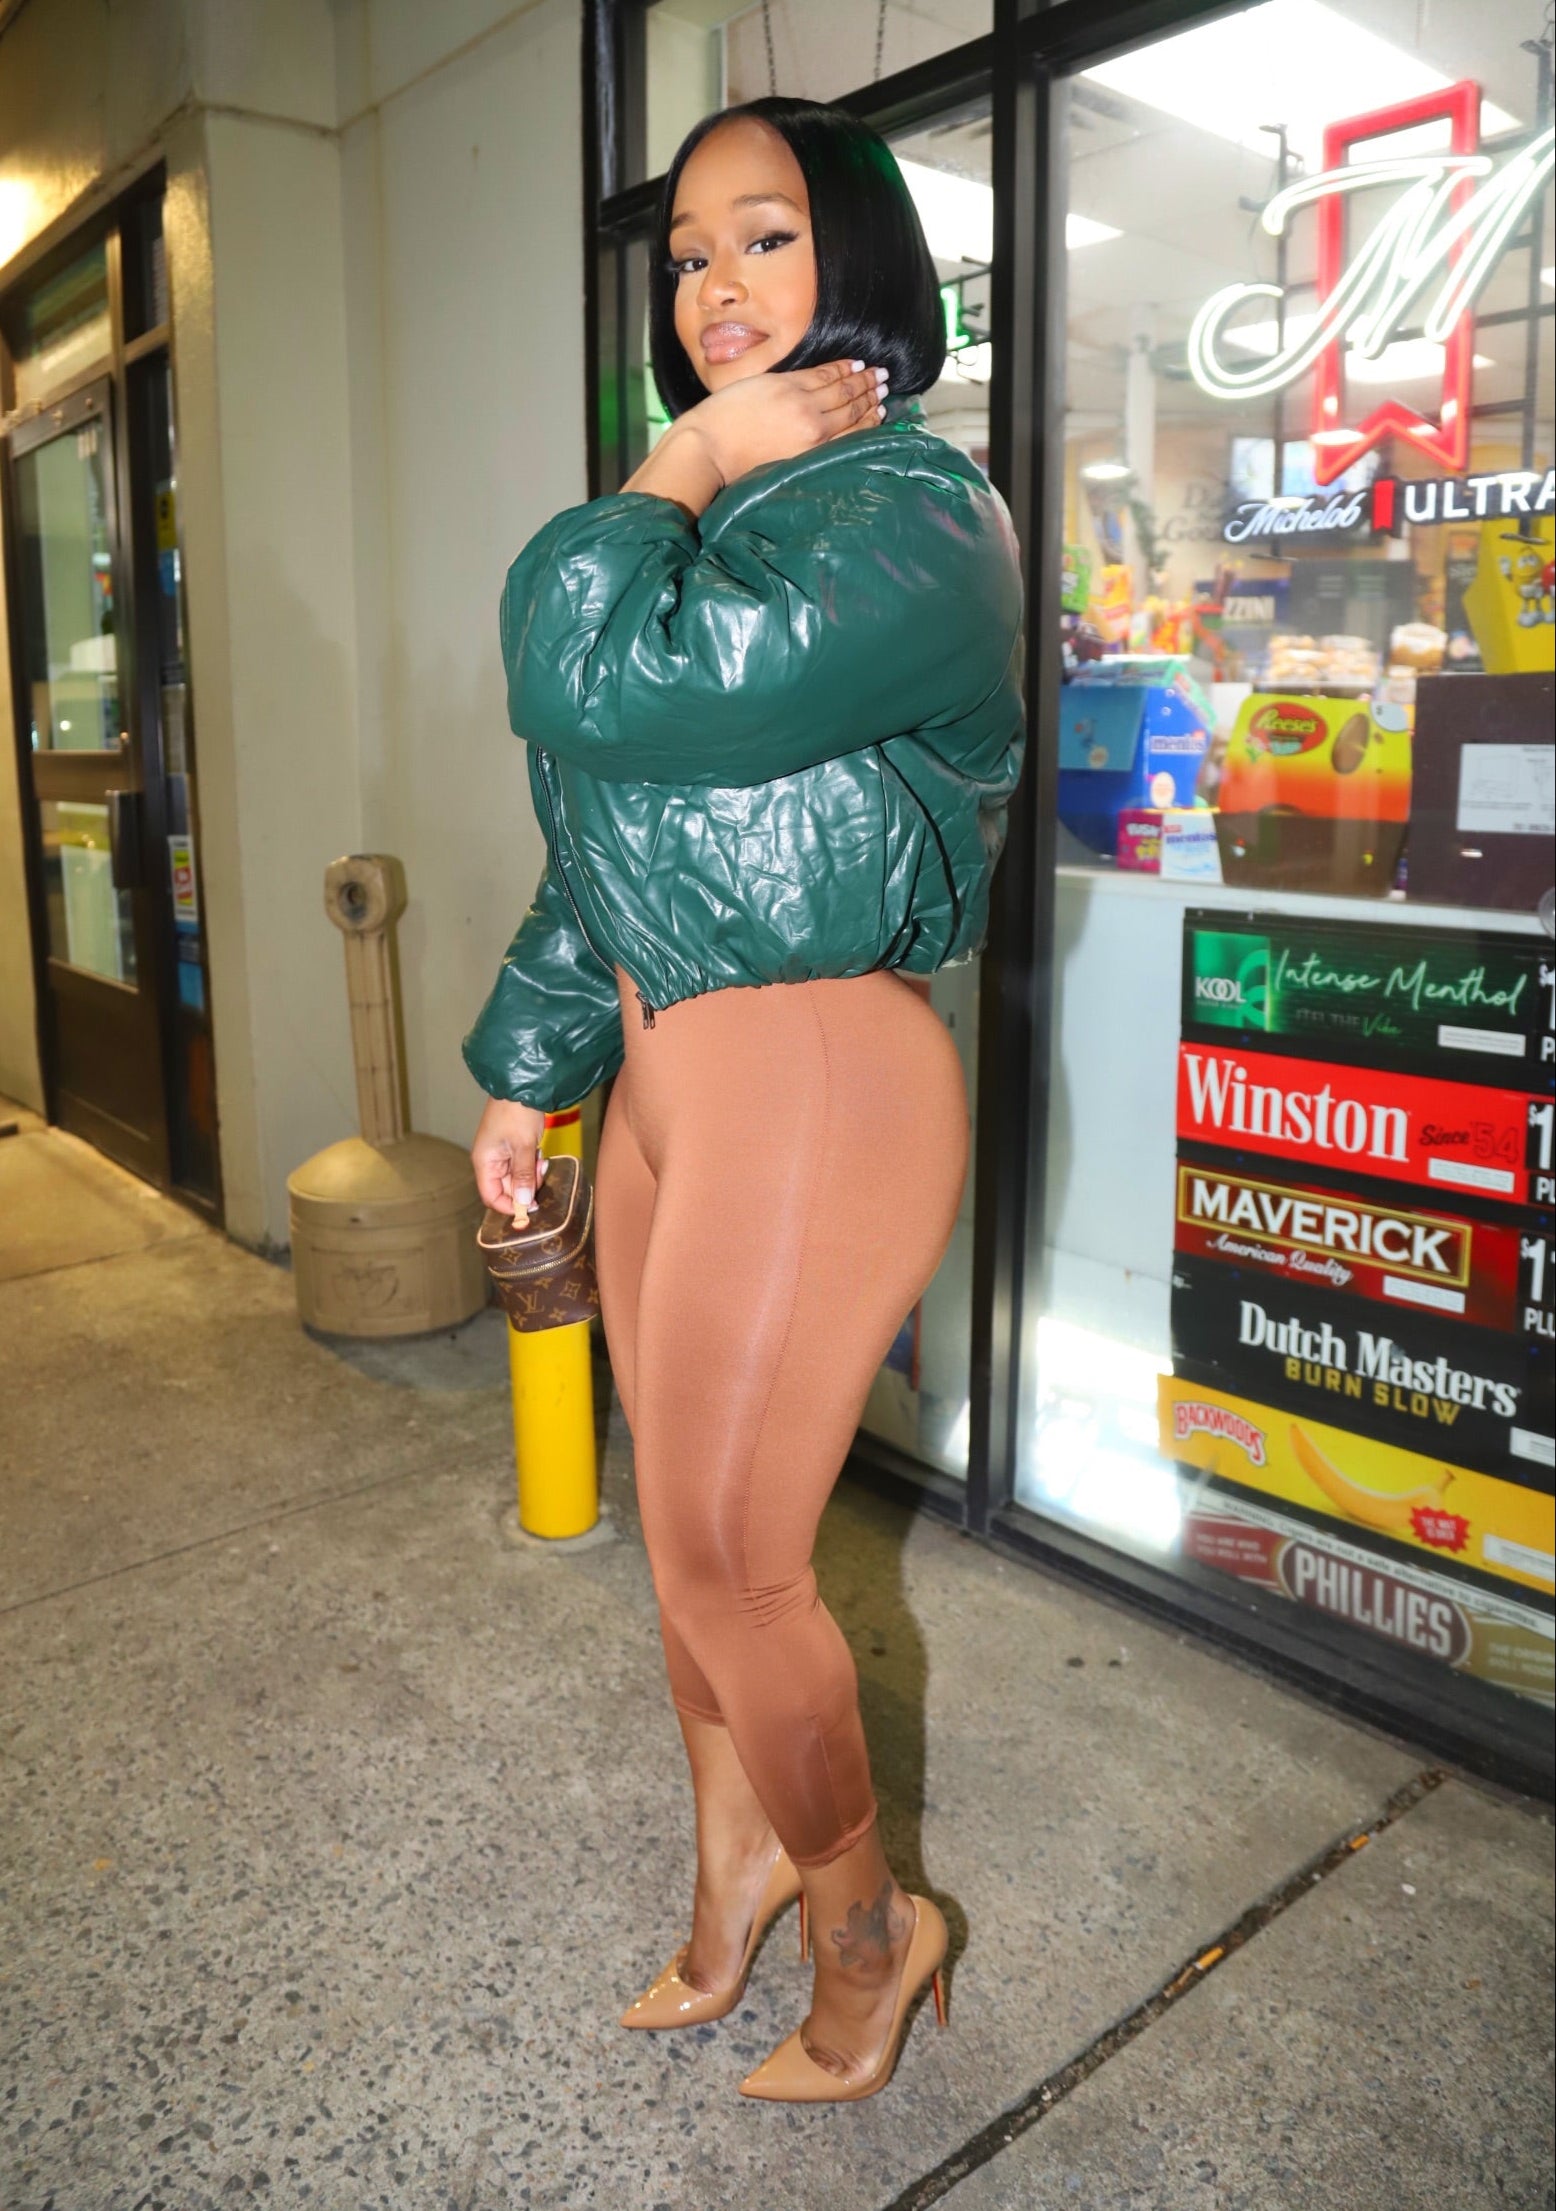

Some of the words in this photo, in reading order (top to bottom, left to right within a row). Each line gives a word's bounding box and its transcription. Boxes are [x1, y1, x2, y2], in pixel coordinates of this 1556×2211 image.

[1224, 492, 1368, 542] Michelob
[1195, 977, 1247, 1003] KOOL
[1274, 949, 1381, 992] Intense
[1385, 960, 1528, 1016] Menthol
[1184, 1053, 1410, 1163] Winston
[1419, 1125, 1470, 1147] Since
[1193, 1178, 1450, 1273] MAVERICK
[1207, 1233, 1286, 1265] American
[1289, 1250, 1353, 1286] Quality
[1239, 1300, 1347, 1371] Dutch
[1357, 1331, 1518, 1418] Masters
[1285, 1357, 1363, 1399] BURN
[1374, 1383, 1461, 1427] SLOW
[1174, 1402, 1266, 1466] BACKWOODS
[1294, 1548, 1453, 1657] PHILLIES
